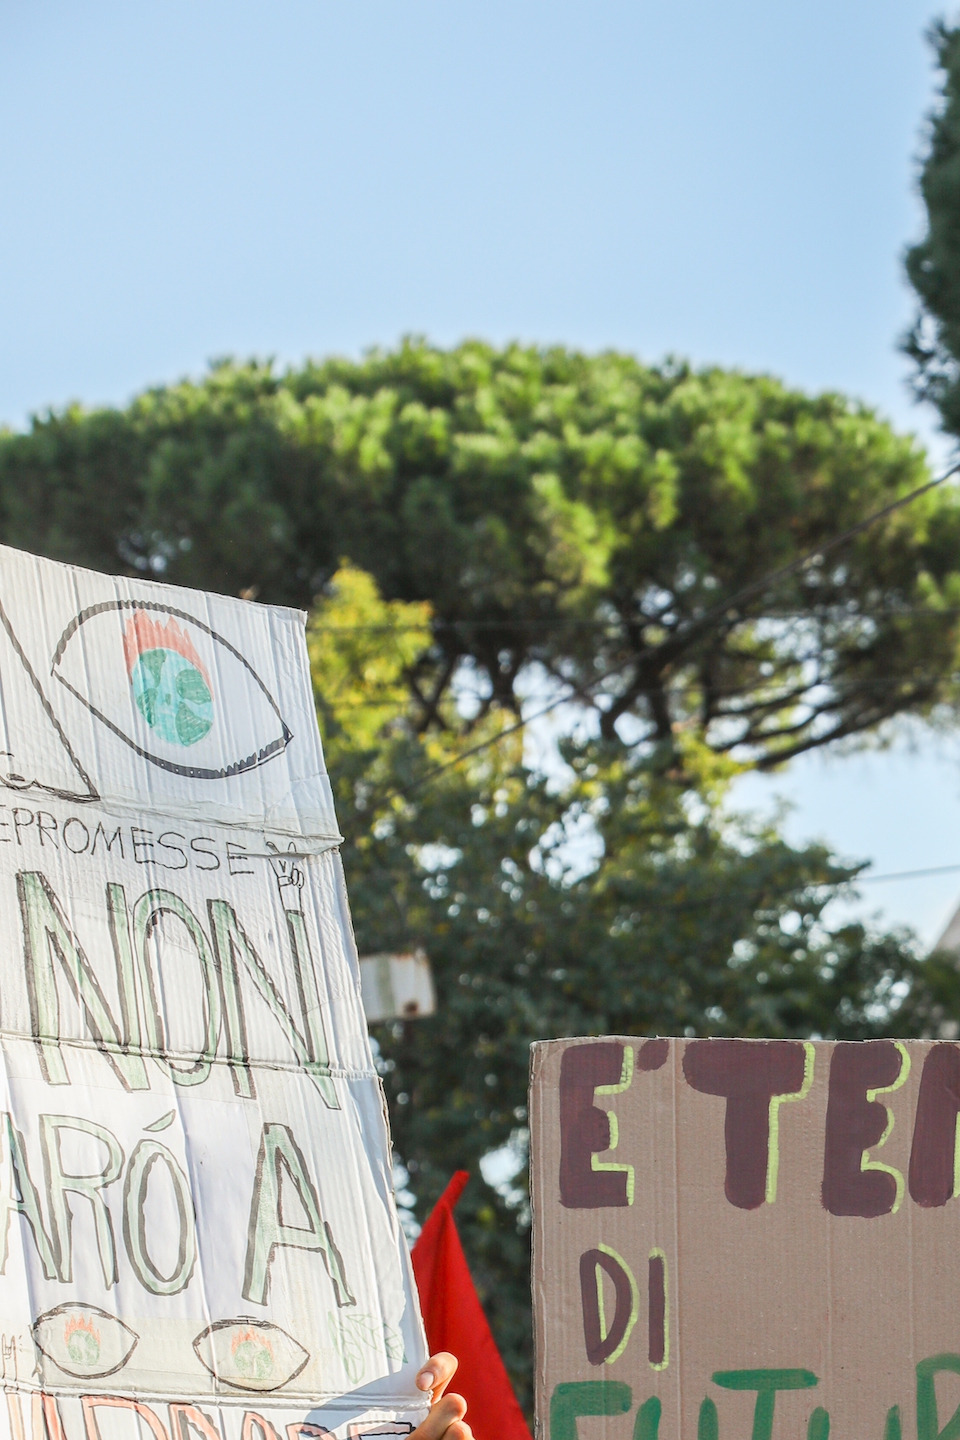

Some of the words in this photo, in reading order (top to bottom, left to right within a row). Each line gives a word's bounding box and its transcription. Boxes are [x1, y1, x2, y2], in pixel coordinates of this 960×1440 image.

[15, 869, 341, 1111] NON
[241, 1122, 357, 1307] A
[579, 1242, 669, 1371] DI
